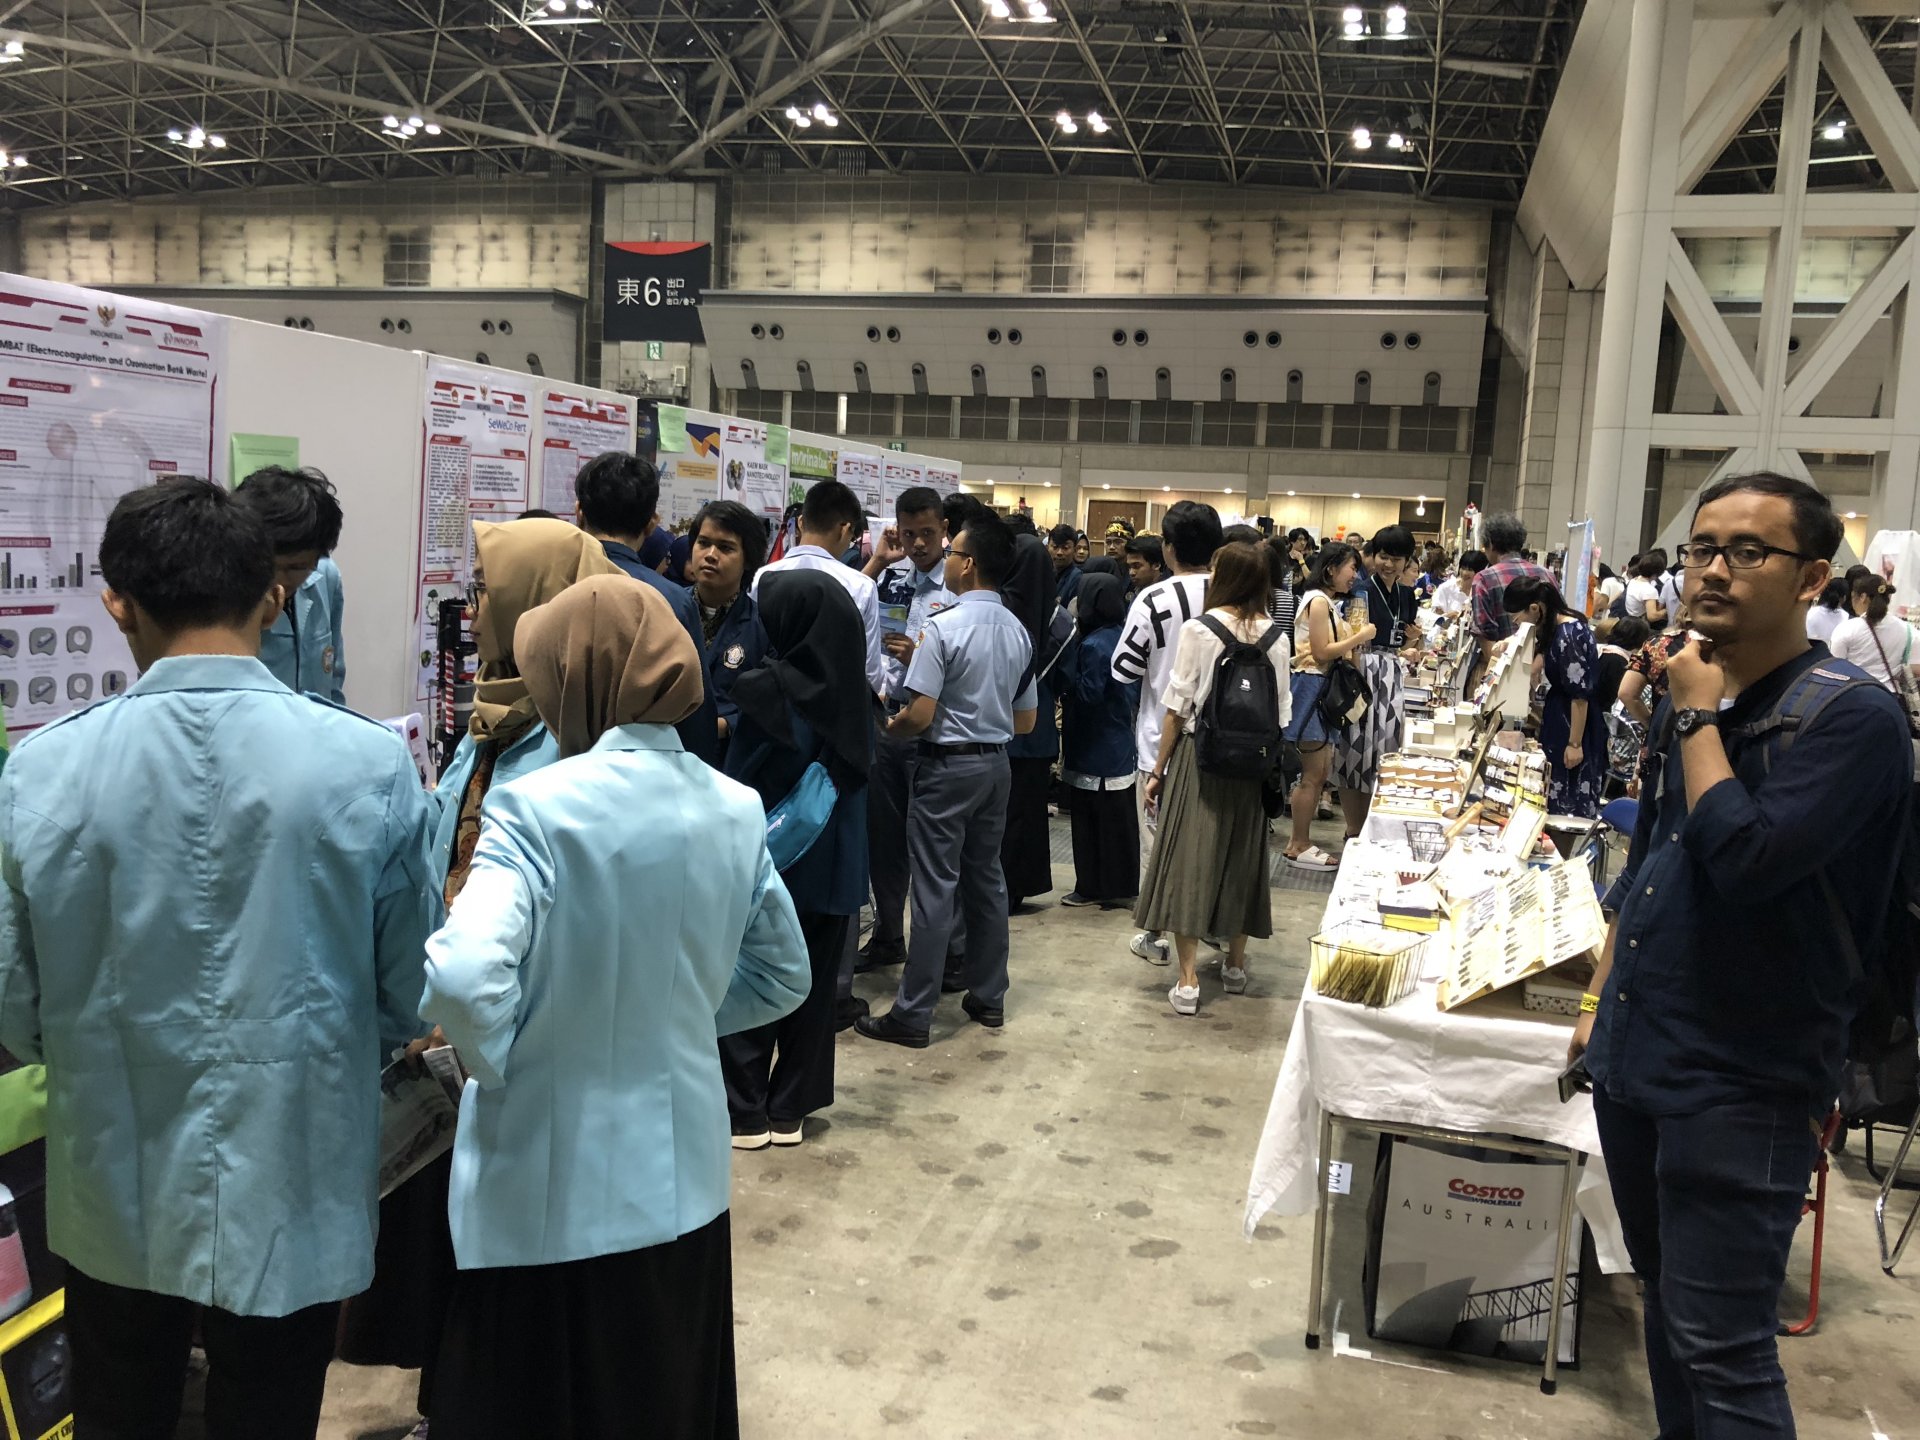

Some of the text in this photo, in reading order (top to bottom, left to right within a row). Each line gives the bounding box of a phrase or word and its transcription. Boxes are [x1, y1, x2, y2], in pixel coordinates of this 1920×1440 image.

[667, 278, 685, 288] 出口
[90, 329, 123, 340] INDONESIA
[108, 357, 123, 366] and
[167, 364, 184, 375] Batik
[1471, 1197, 1522, 1207] WHOLESALE
[1402, 1198, 1548, 1231] AUSTRALI
